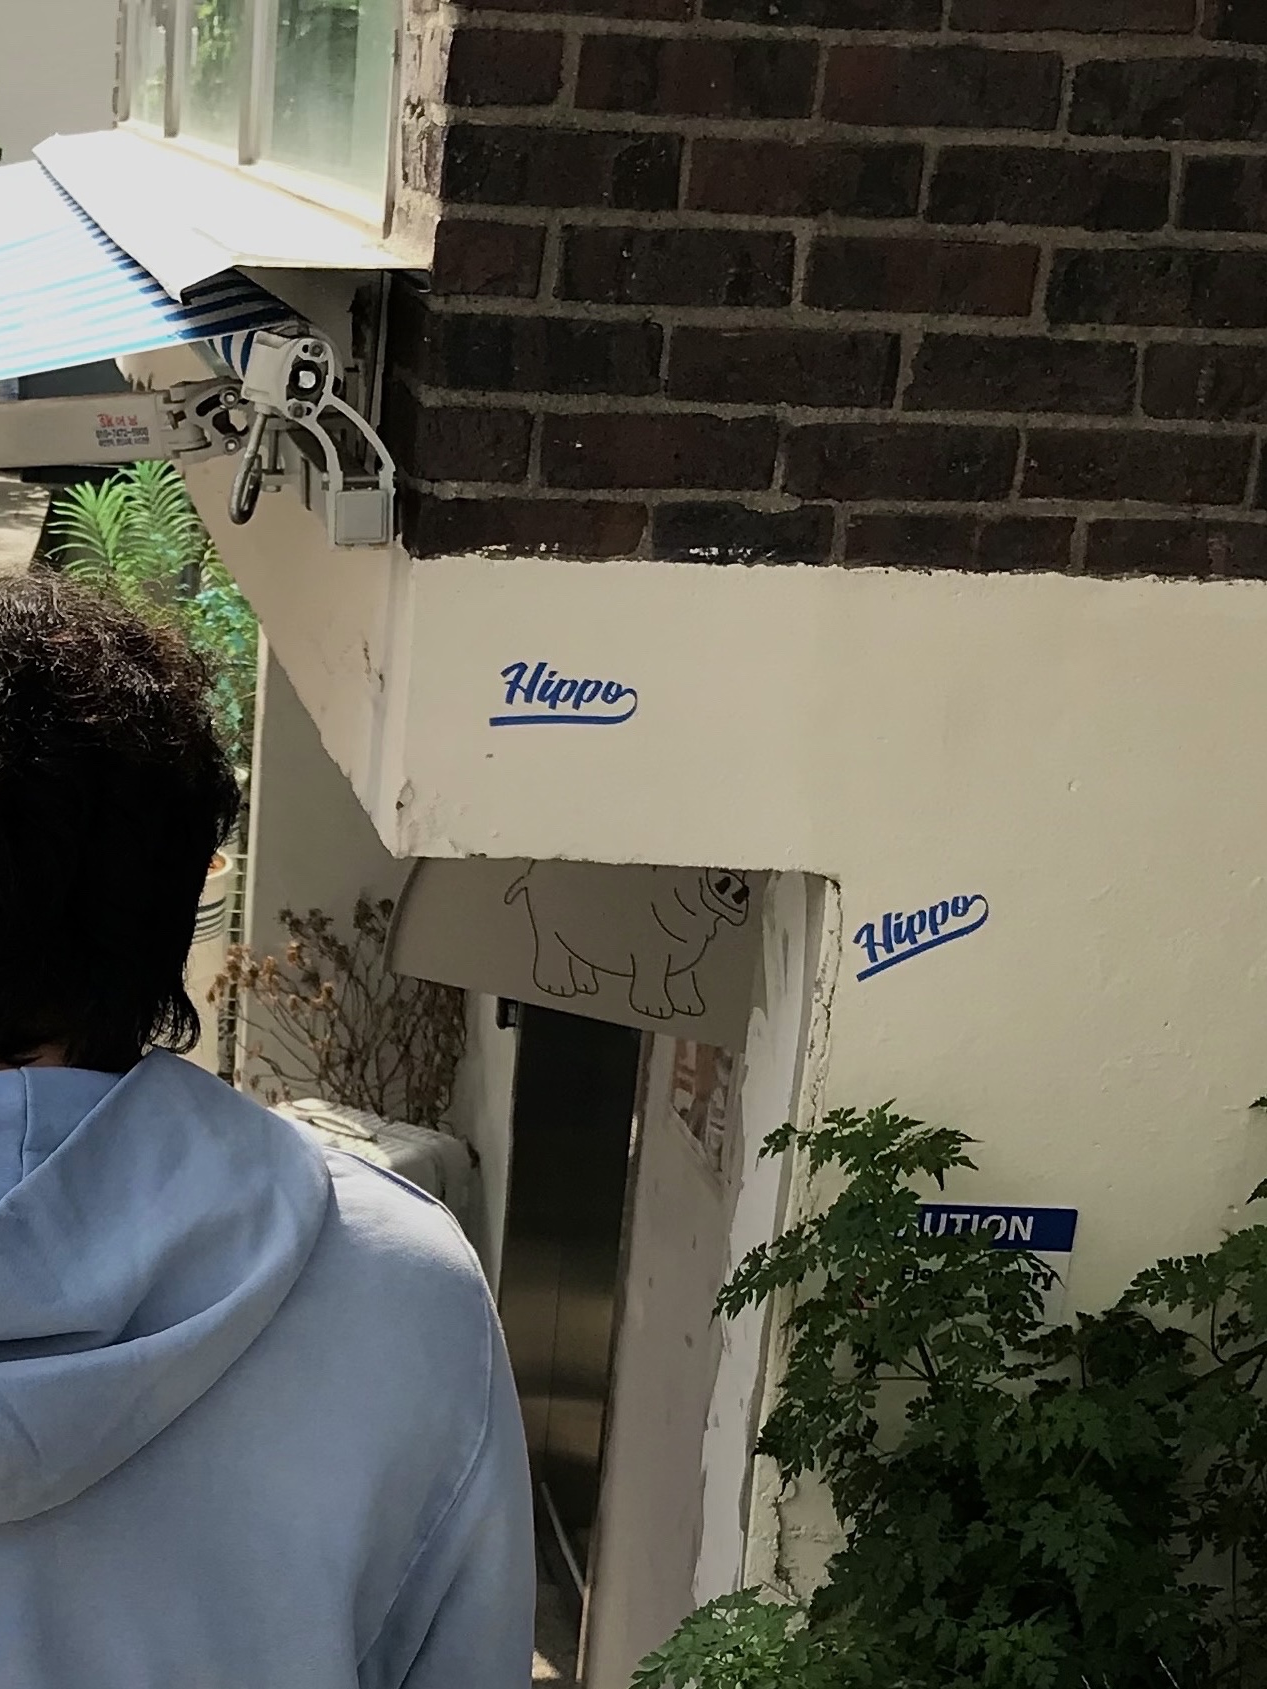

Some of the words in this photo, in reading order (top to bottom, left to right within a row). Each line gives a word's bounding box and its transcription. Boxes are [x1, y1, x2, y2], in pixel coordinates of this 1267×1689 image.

[497, 661, 637, 716] Hippo
[853, 894, 989, 966] Hippo
[893, 1211, 1035, 1242] UTION
